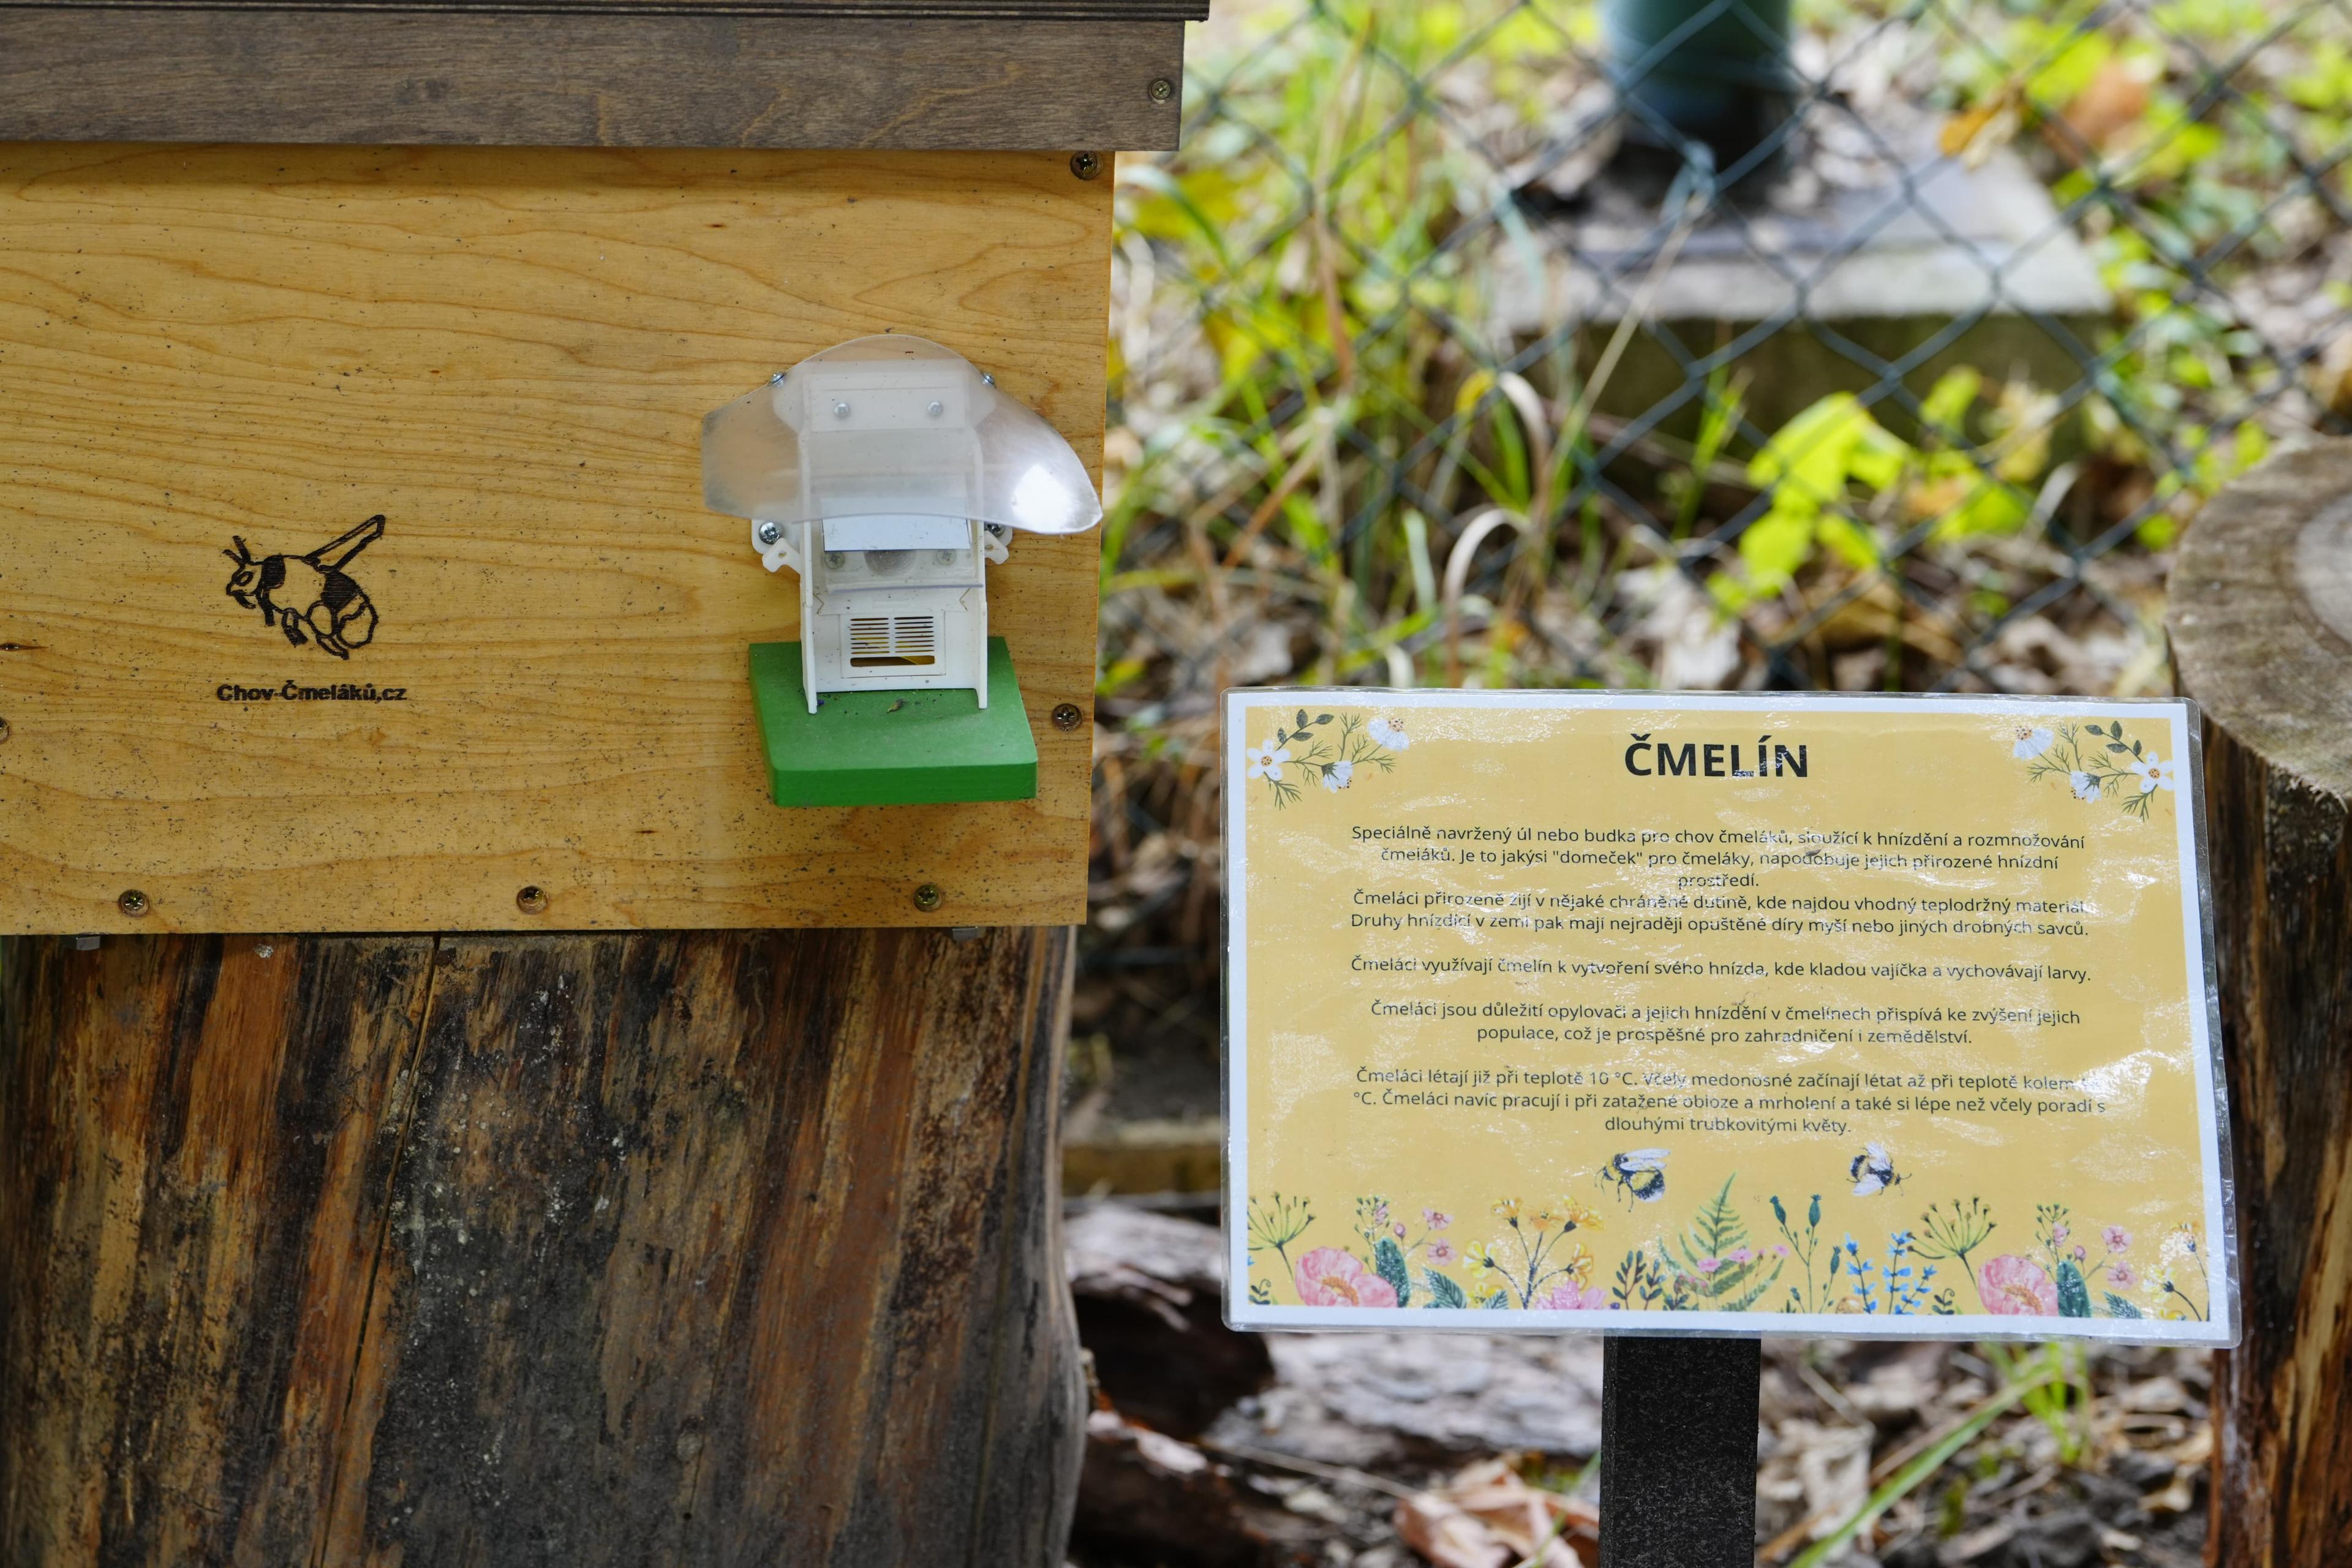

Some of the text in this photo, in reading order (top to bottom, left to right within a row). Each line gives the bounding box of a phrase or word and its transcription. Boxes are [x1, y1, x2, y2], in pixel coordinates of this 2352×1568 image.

[1625, 734, 1807, 777] ČMELÍN
[1352, 826, 1431, 843] Speciálně
[1437, 826, 1512, 844] navržený
[1518, 827, 1531, 840] úl
[1537, 828, 1578, 842] nebo
[1585, 829, 1635, 842] budka
[1642, 833, 1669, 846] pro
[1675, 829, 1714, 843] chov
[1719, 830, 1792, 845] čmeláků,
[1864, 832, 1872, 845] k
[1877, 832, 1948, 846] hnízdění
[1953, 836, 1962, 846] a
[1968, 834, 2084, 849] rozmnožování
[1459, 849, 1475, 864] Je
[1480, 851, 1496, 862] to
[1501, 850, 1547, 866] jakýsi
[1553, 850, 1642, 864] "domeček"
[1649, 855, 1676, 868] pro
[1683, 851, 1754, 868] čmeláky,
[1760, 853, 1860, 869] napodobuje
[1864, 854, 1907, 870] jejich
[1913, 854, 1992, 870] přirozené
[1998, 855, 2058, 869] hnízdní
[1679, 873, 1758, 890] prostředí.
[1354, 888, 1418, 905] Čmeláci
[1425, 892, 1504, 908] přirozeně
[1536, 897, 1545, 907] v
[1550, 894, 1604, 911] nějaké
[1610, 895, 1688, 908] chráněné
[1694, 895, 1751, 910] dutině,
[1757, 895, 1786, 909] kde
[1792, 897, 1849, 913] najdou
[1854, 897, 1917, 914] vhodný
[1921, 898, 2011, 914] teplodržný
[1352, 913, 1402, 930] Druhy
[1476, 918, 1485, 927] v
[1490, 914, 1528, 927] zemi
[1535, 916, 1564, 932] pak
[1570, 917, 1604, 933] mají
[1610, 917, 1682, 933] nejraději
[1688, 918, 1766, 934] opuštěné
[1772, 918, 1803, 935] díry
[1809, 919, 1847, 935] myší
[1852, 919, 1894, 932] nebo
[1899, 919, 1947, 936] jiných
[1953, 920, 2032, 937] drobných
[2038, 921, 2087, 935] savců.
[1352, 954, 2090, 984] Čmeláci využívají čmelín k vytvoření svého hnízda, kde kladou vajíčka a vychovávají larvy.
[1371, 999, 2079, 1027] Čmeláci jsou důležití opylovači a jejich hnízdění v čmelínech přispívá ke zvýšení jejich
[1478, 1025, 1558, 1042] populace,
[1564, 1027, 1591, 1039] což
[1596, 1028, 1611, 1044] je
[1617, 1028, 1705, 1045] prospěšné
[1711, 1032, 1739, 1046] pro
[1744, 1029, 1853, 1042] zahradničení
[1868, 1030, 1972, 1043] zemědělství.
[1357, 1066, 1422, 1084] Čmeláci
[1429, 1069, 1468, 1087] létají
[1472, 1069, 1490, 1087] již
[1496, 1071, 1518, 1088] při
[1524, 1071, 1583, 1088] teplotě
[1589, 1072, 1608, 1085] 10
[1615, 1072, 1637, 1085] °C.
[1692, 1073, 1792, 1087] medonosné
[1798, 1073, 1860, 1091] začínají
[1865, 1074, 1902, 1087] létat
[1908, 1074, 1926, 1087] až
[1931, 1074, 1953, 1091] při
[1958, 1075, 2018, 1091] teplotě
[2024, 1076, 2073, 1090] kolem
[1354, 1091, 1376, 1105] °C.
[1383, 1088, 1448, 1106] Čmeláci
[1455, 1093, 1497, 1107] navíc
[1503, 1094, 1560, 1111] pracují
[1575, 1093, 1596, 1111] při
[1603, 1094, 1677, 1107] zatažené
[1744, 1099, 1753, 1109] a
[1760, 1095, 1836, 1109] mrholení
[1841, 1100, 1850, 1110] a
[1855, 1096, 1891, 1110] také
[1897, 1097, 1909, 1110] si
[1915, 1096, 1950, 1114] lépe
[1956, 1098, 1985, 1111] než
[1990, 1098, 2032, 1115] včely
[2038, 1099, 2092, 1115] poradí
[2097, 1102, 2105, 1112] s
[1605, 1117, 1851, 1136] dlouhými trubkovitými květy.
